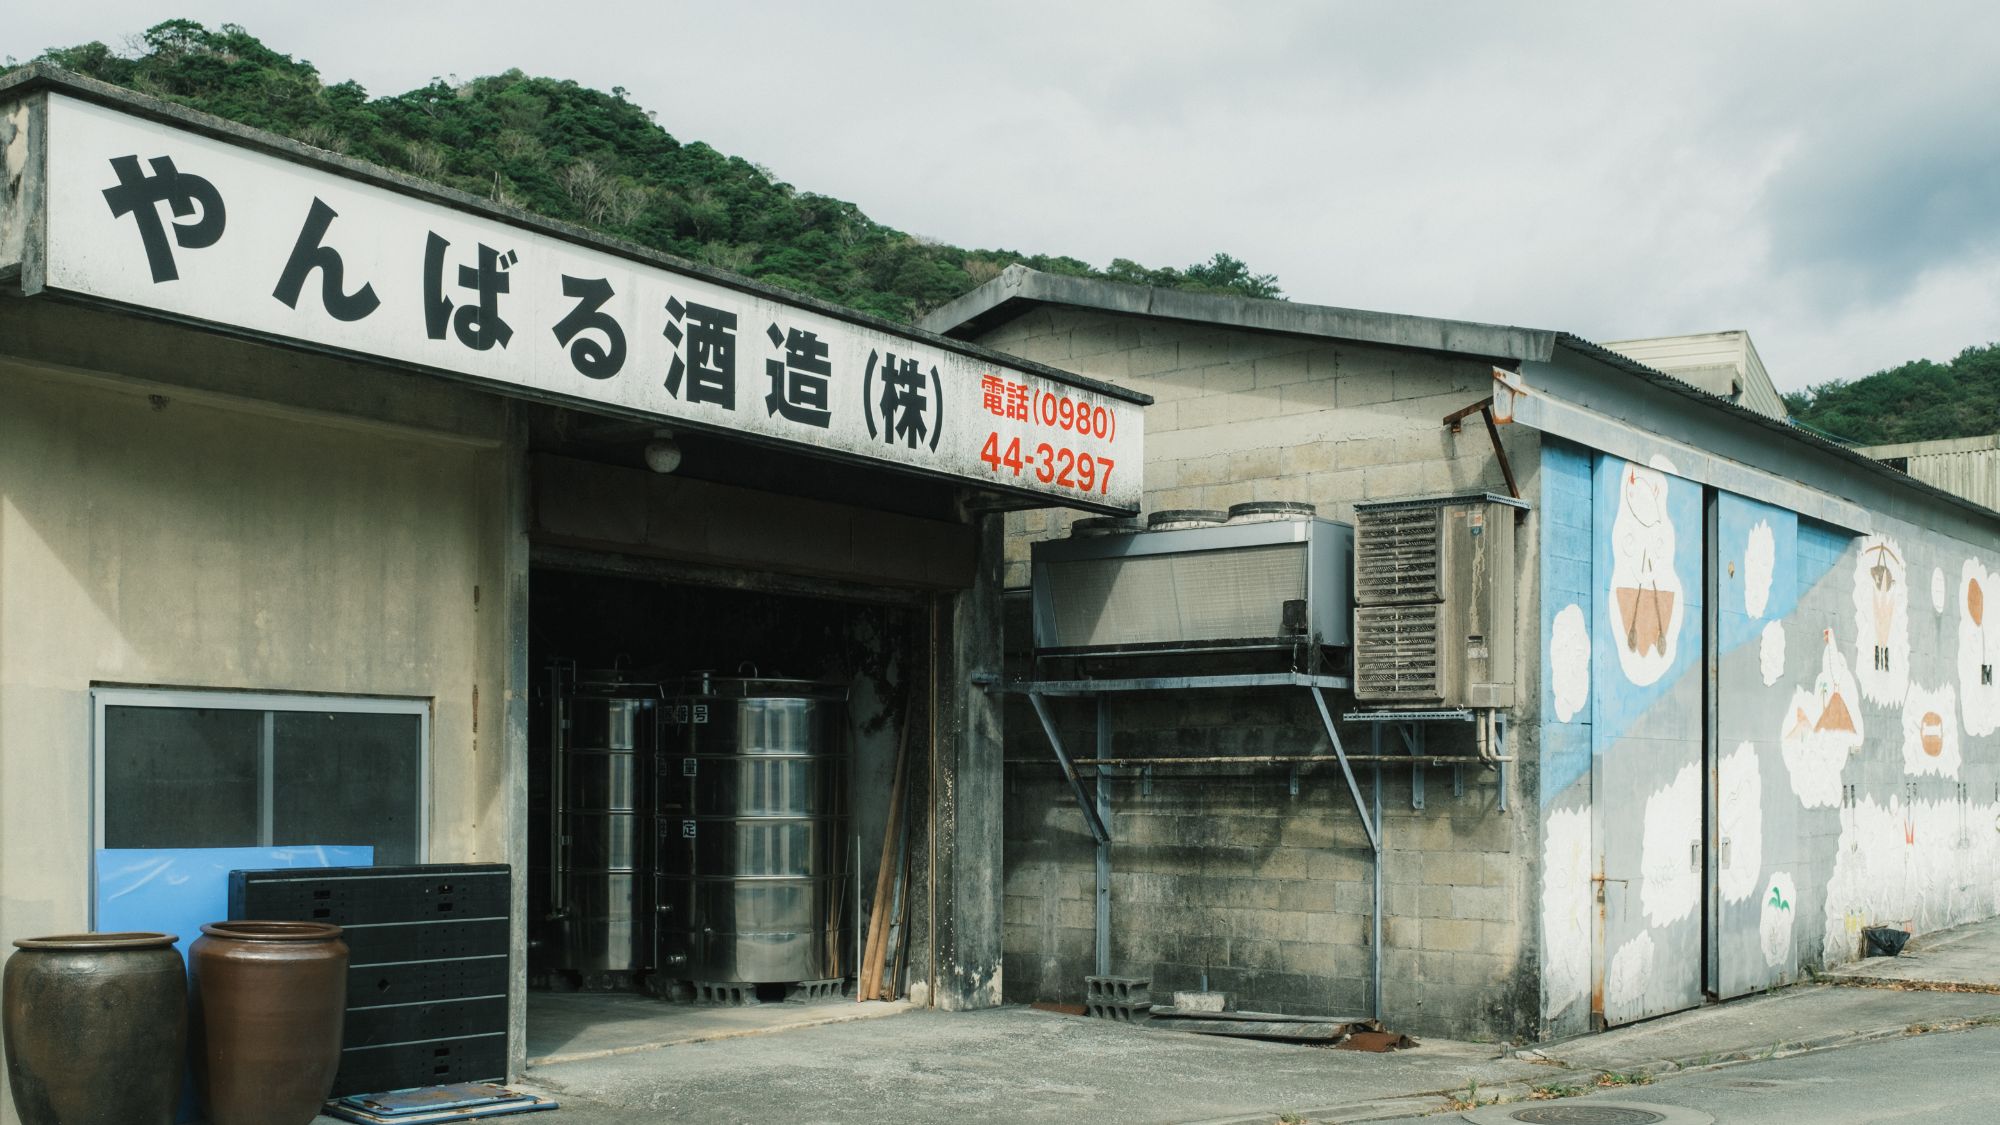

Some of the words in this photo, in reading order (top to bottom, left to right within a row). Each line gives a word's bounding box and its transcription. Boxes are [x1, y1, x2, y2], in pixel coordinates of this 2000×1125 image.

[102, 154, 944, 453] やんばる酒造(株)
[981, 374, 1115, 443] 電話(0980)
[980, 431, 1114, 494] 44-3297
